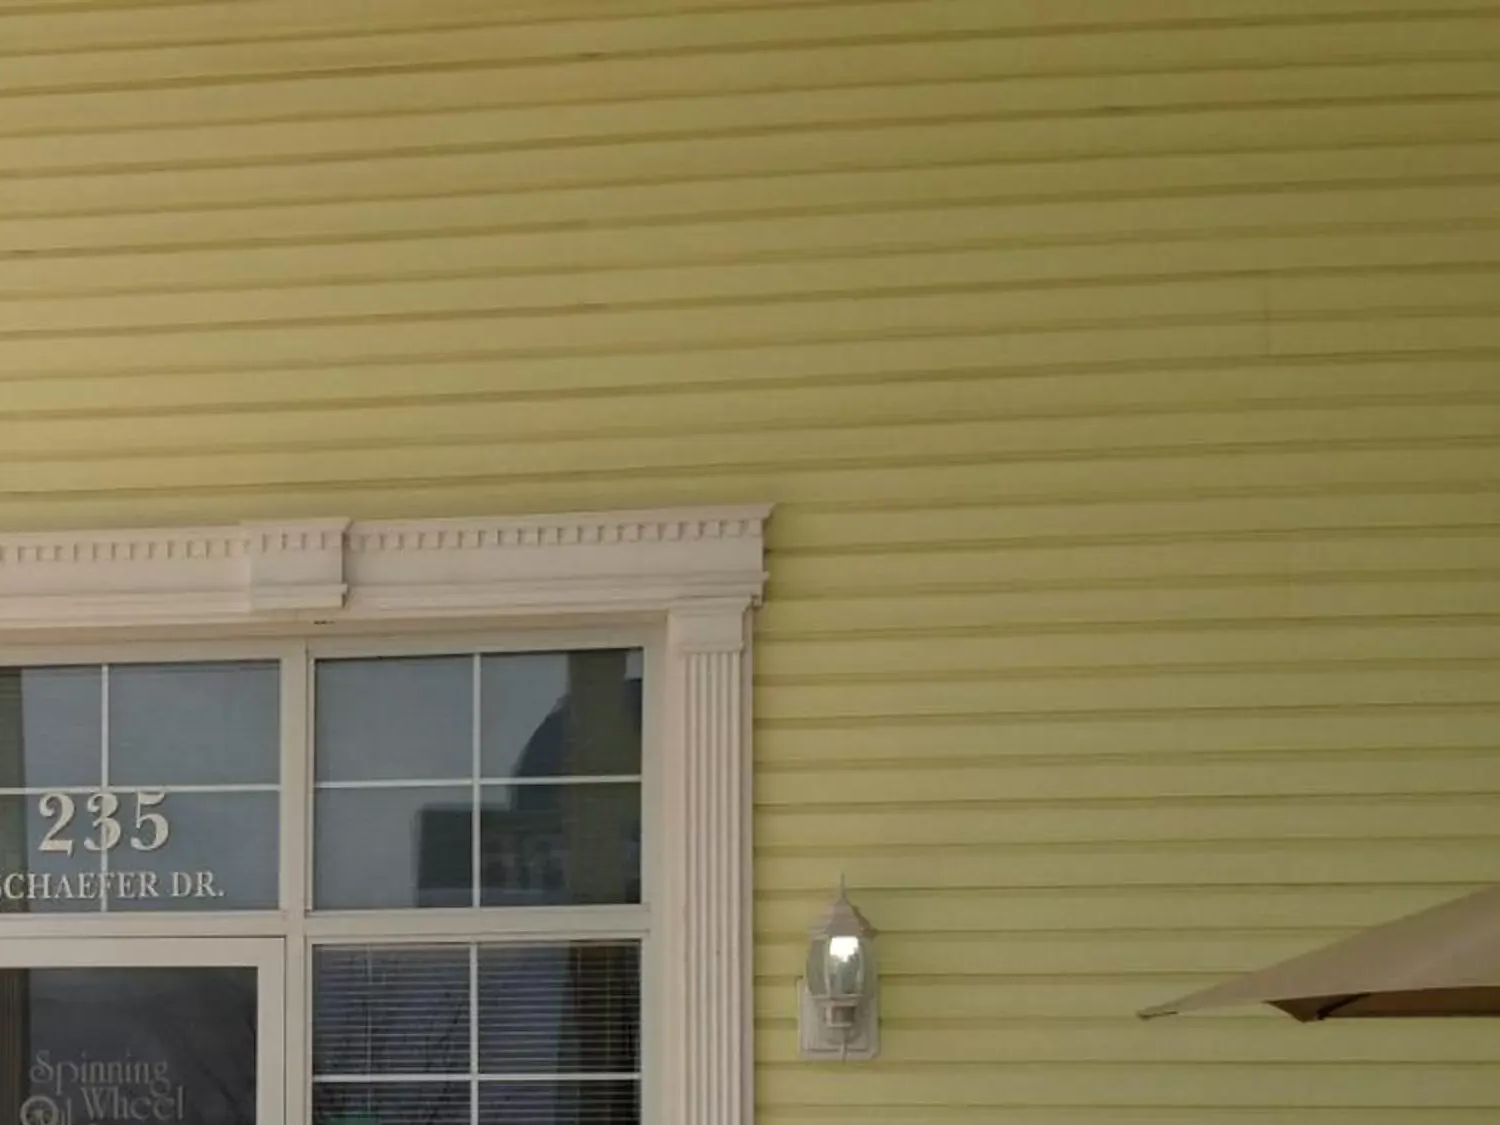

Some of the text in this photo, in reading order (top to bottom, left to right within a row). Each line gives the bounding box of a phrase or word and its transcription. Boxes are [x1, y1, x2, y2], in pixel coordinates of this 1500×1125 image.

[38, 790, 170, 857] 235
[170, 871, 226, 898] DR.
[30, 1050, 171, 1098] Spinning
[80, 1085, 184, 1121] Wheel
